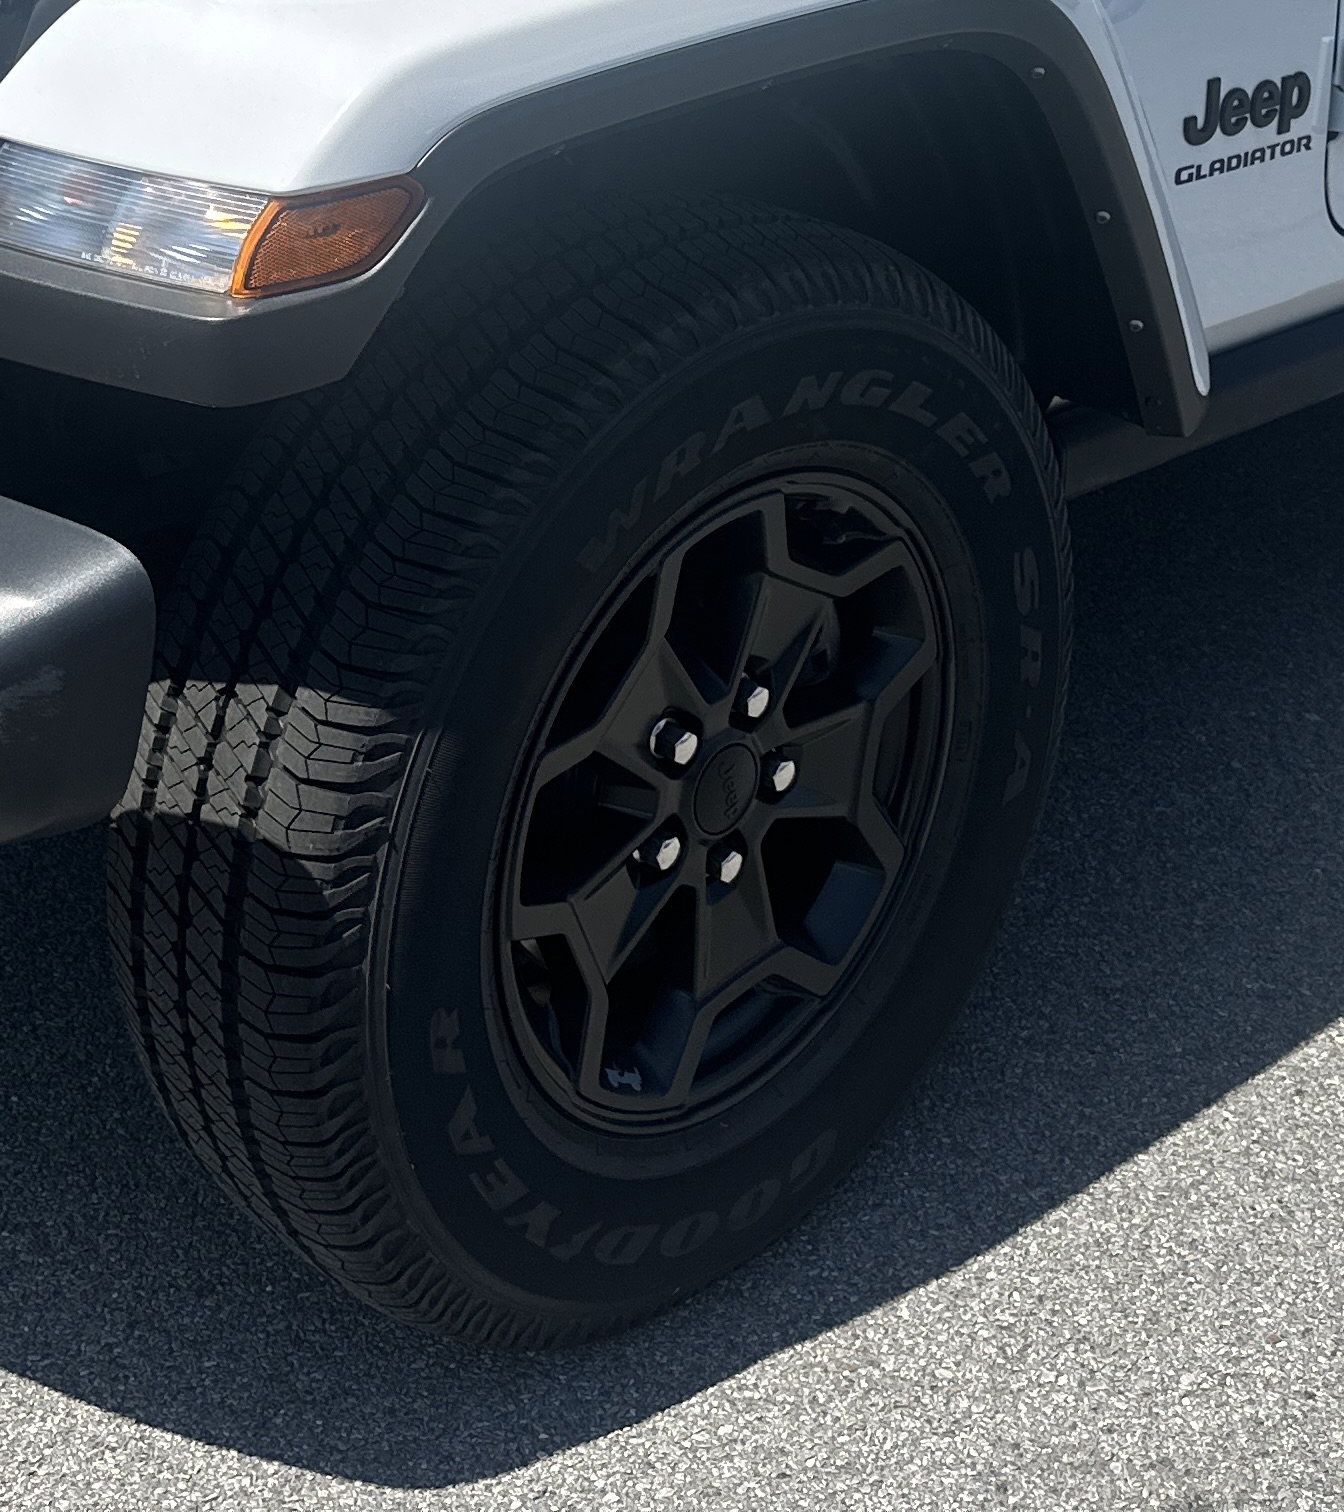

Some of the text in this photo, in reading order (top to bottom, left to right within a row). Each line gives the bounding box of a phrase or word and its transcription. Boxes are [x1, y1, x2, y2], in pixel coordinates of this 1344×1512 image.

[1183, 71, 1311, 146] Jeep
[1175, 135, 1312, 185] GLADIATOR
[576, 368, 1013, 573] WRANGLER
[718, 761, 742, 819] Jeep
